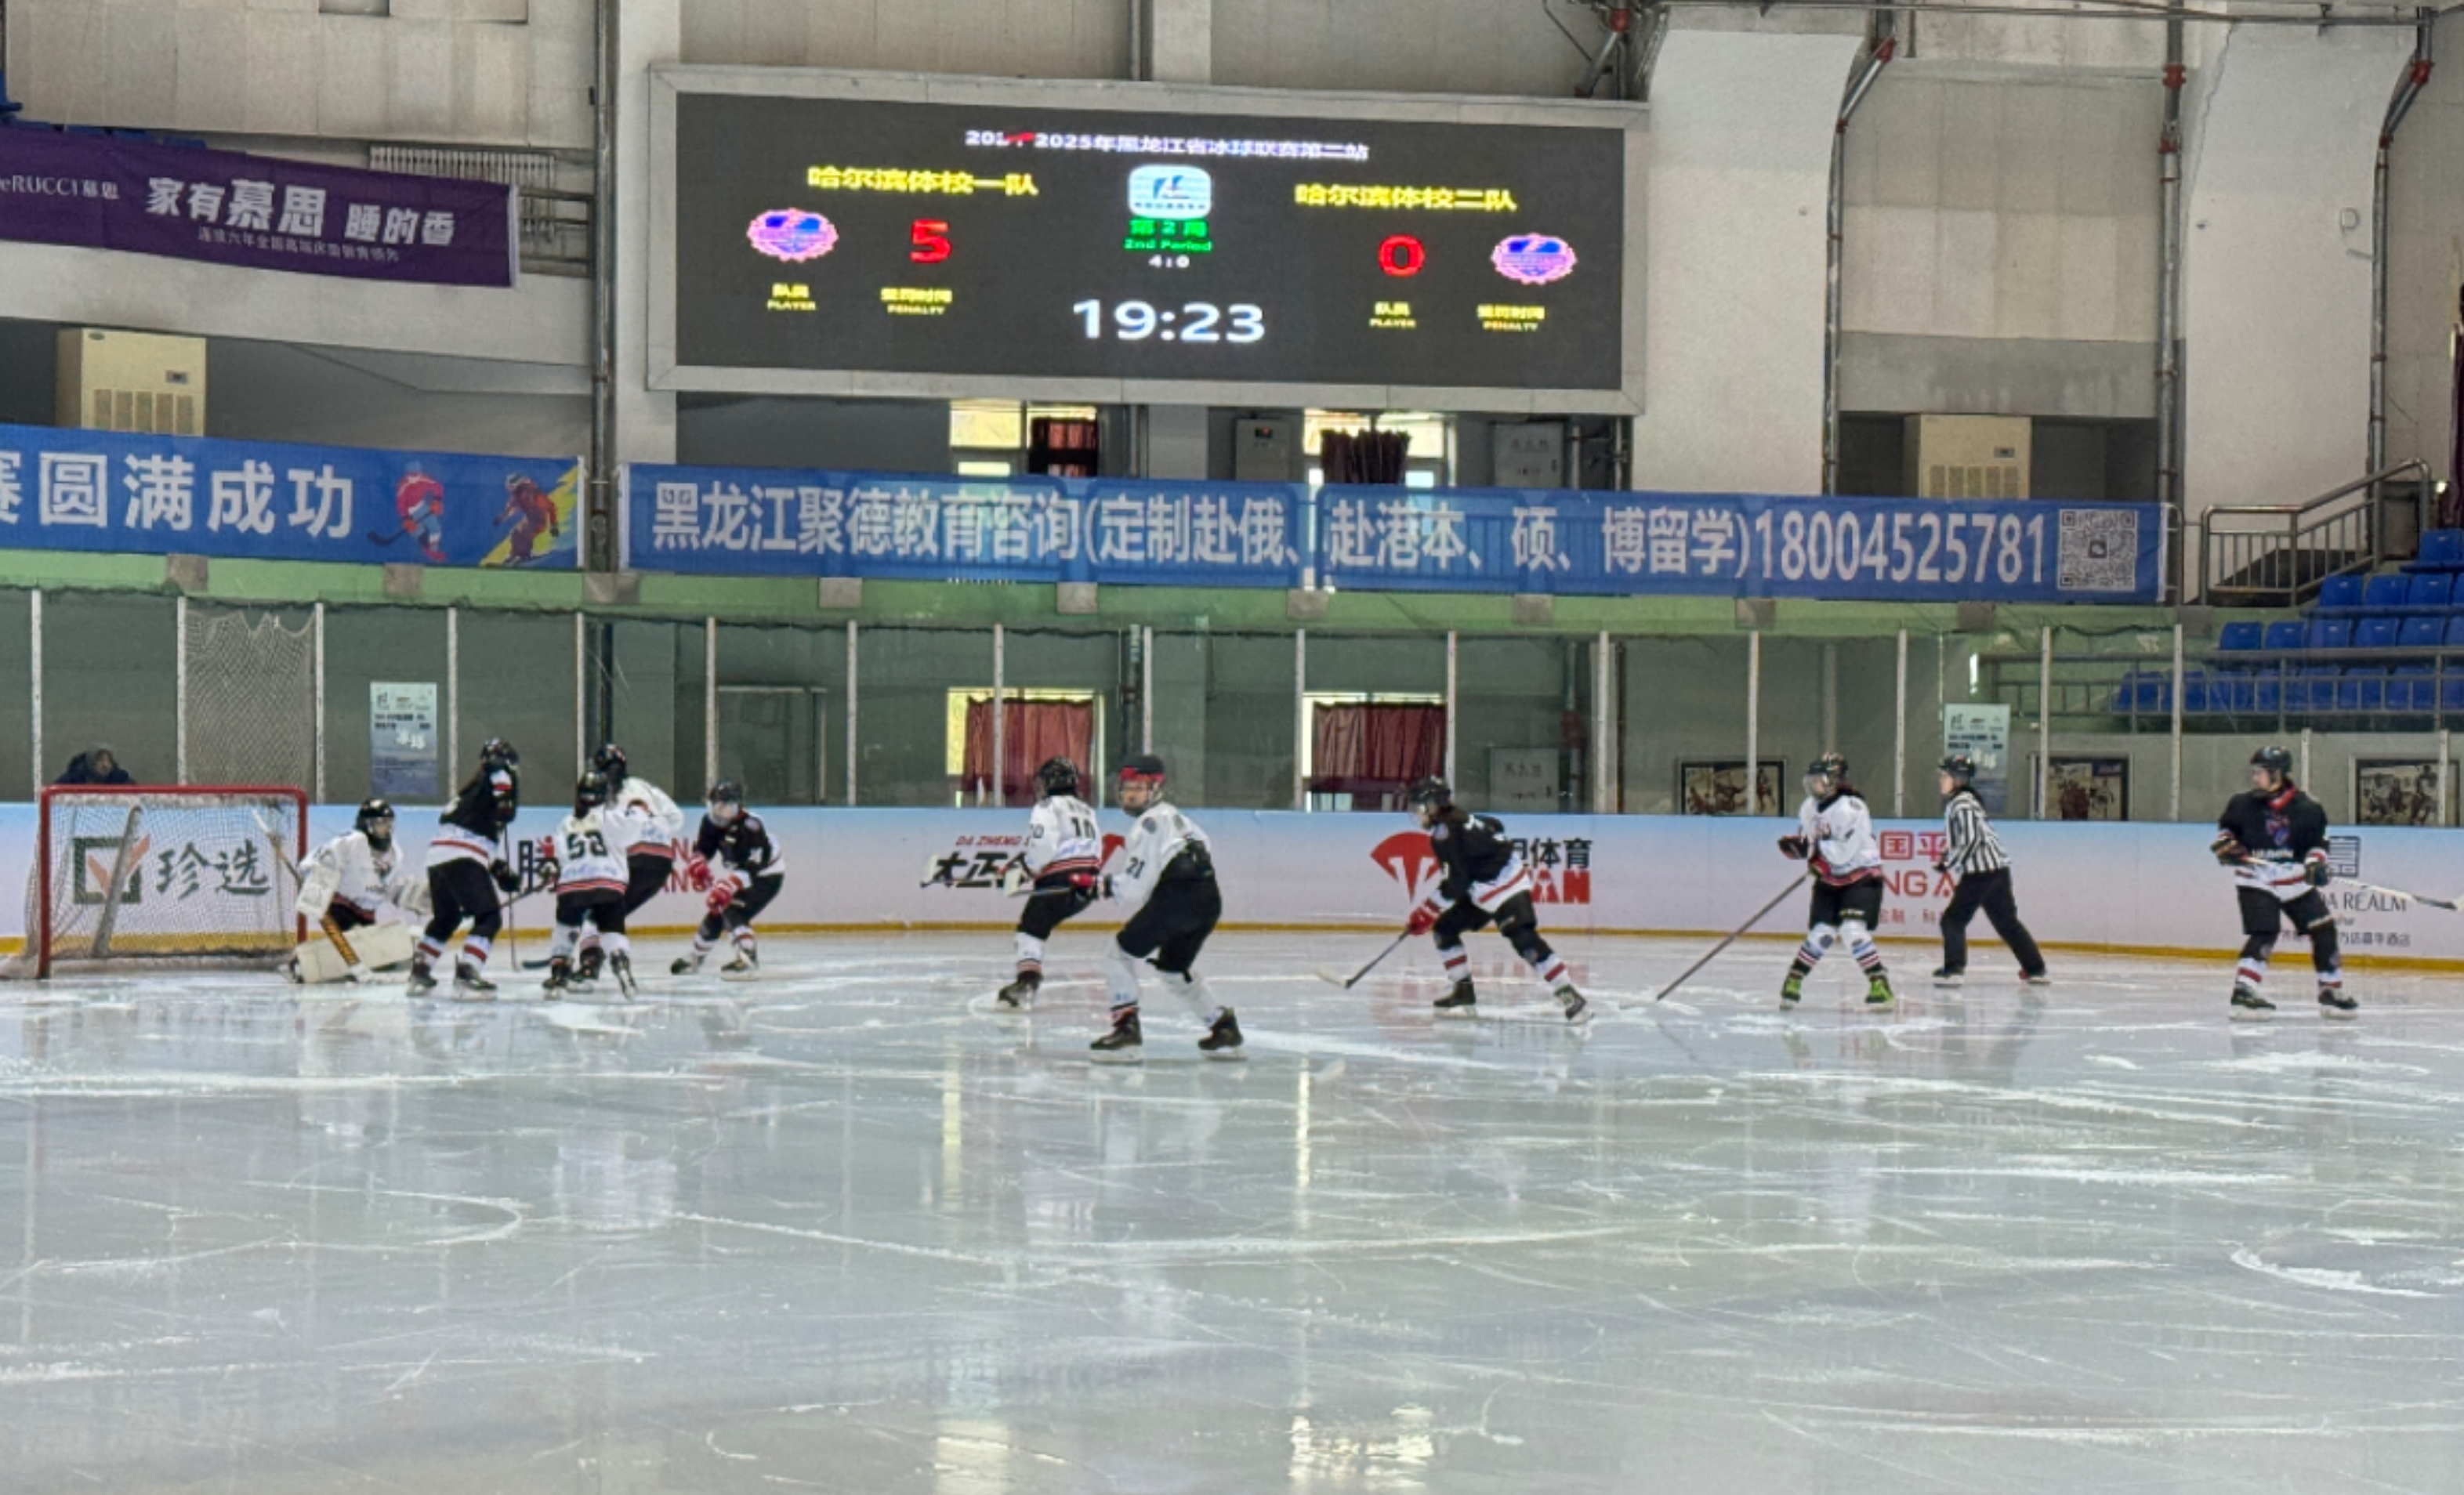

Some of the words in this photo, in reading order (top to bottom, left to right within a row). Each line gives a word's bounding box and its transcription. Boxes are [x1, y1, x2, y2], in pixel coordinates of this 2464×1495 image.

[807, 166, 1039, 196] 哈尔滨体校一队
[1295, 183, 1517, 212] 哈尔滨体校二队
[145, 176, 327, 237] 家有慕思
[344, 203, 455, 247] 睡的香
[909, 219, 951, 263] 5
[1124, 237, 1156, 249] 2nd
[1160, 238, 1212, 252] Period
[1147, 254, 1190, 268] 4:0
[1379, 234, 1425, 276] 0
[767, 299, 816, 311] PLAYER
[887, 304, 945, 315] PENALTY
[1073, 299, 1266, 342] 19:23
[1369, 317, 1416, 328] PLAYER
[1483, 320, 1538, 332] PENALTY
[156, 838, 273, 901] 珍选
[1126, 856, 1145, 879] 21
[1528, 869, 1591, 905] AN
[2343, 891, 2408, 912] REALM
